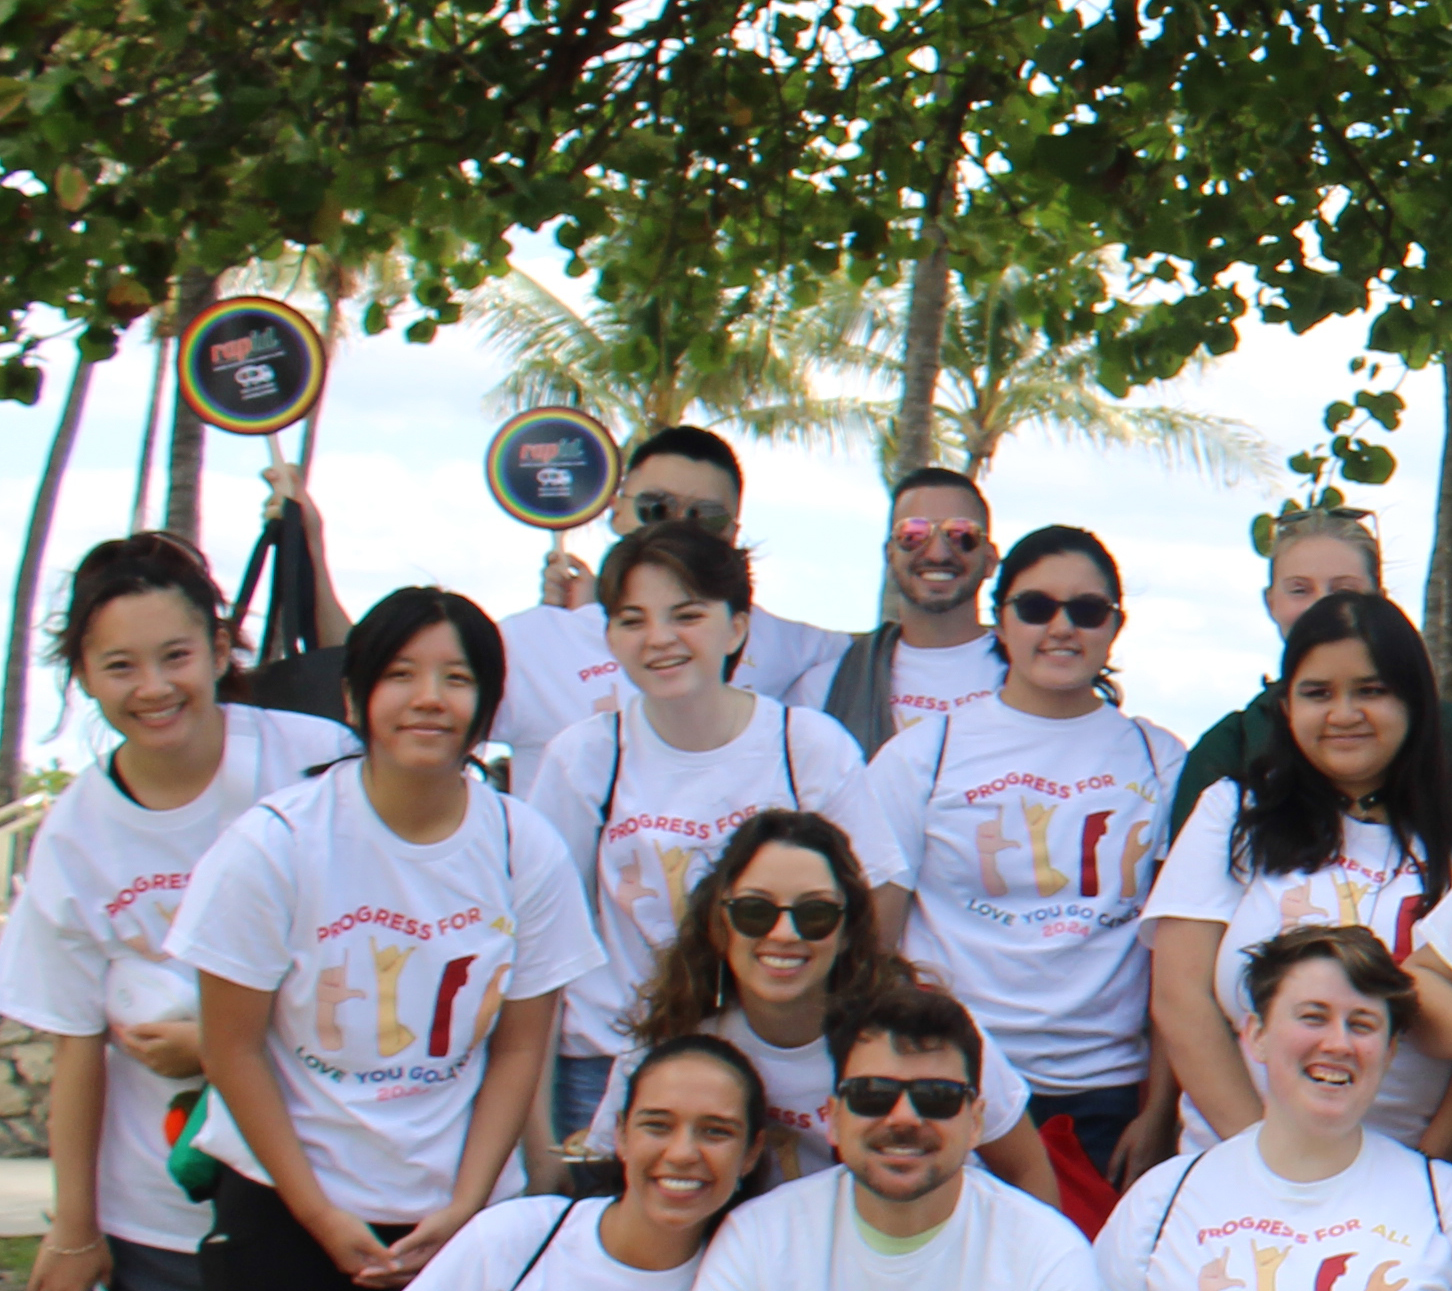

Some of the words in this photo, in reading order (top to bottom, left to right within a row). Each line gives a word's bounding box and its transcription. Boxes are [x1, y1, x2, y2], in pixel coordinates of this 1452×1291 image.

[965, 772, 1071, 804] PROGRESS
[1077, 774, 1115, 793] FOR
[609, 814, 711, 842] PROGRESS
[318, 906, 432, 942] PROGRESS
[438, 907, 483, 935] FOR
[967, 898, 1014, 926] LOVE
[1022, 905, 1062, 924] YOU
[1066, 904, 1093, 919] GO
[1042, 922, 1088, 939] 2024
[296, 1046, 346, 1083] LOVE
[355, 1067, 403, 1084] YOU
[410, 1066, 440, 1084] GO
[1197, 1216, 1309, 1246] PROGRESS
[1316, 1218, 1360, 1241] FOR
[1371, 1223, 1413, 1248] ALL
